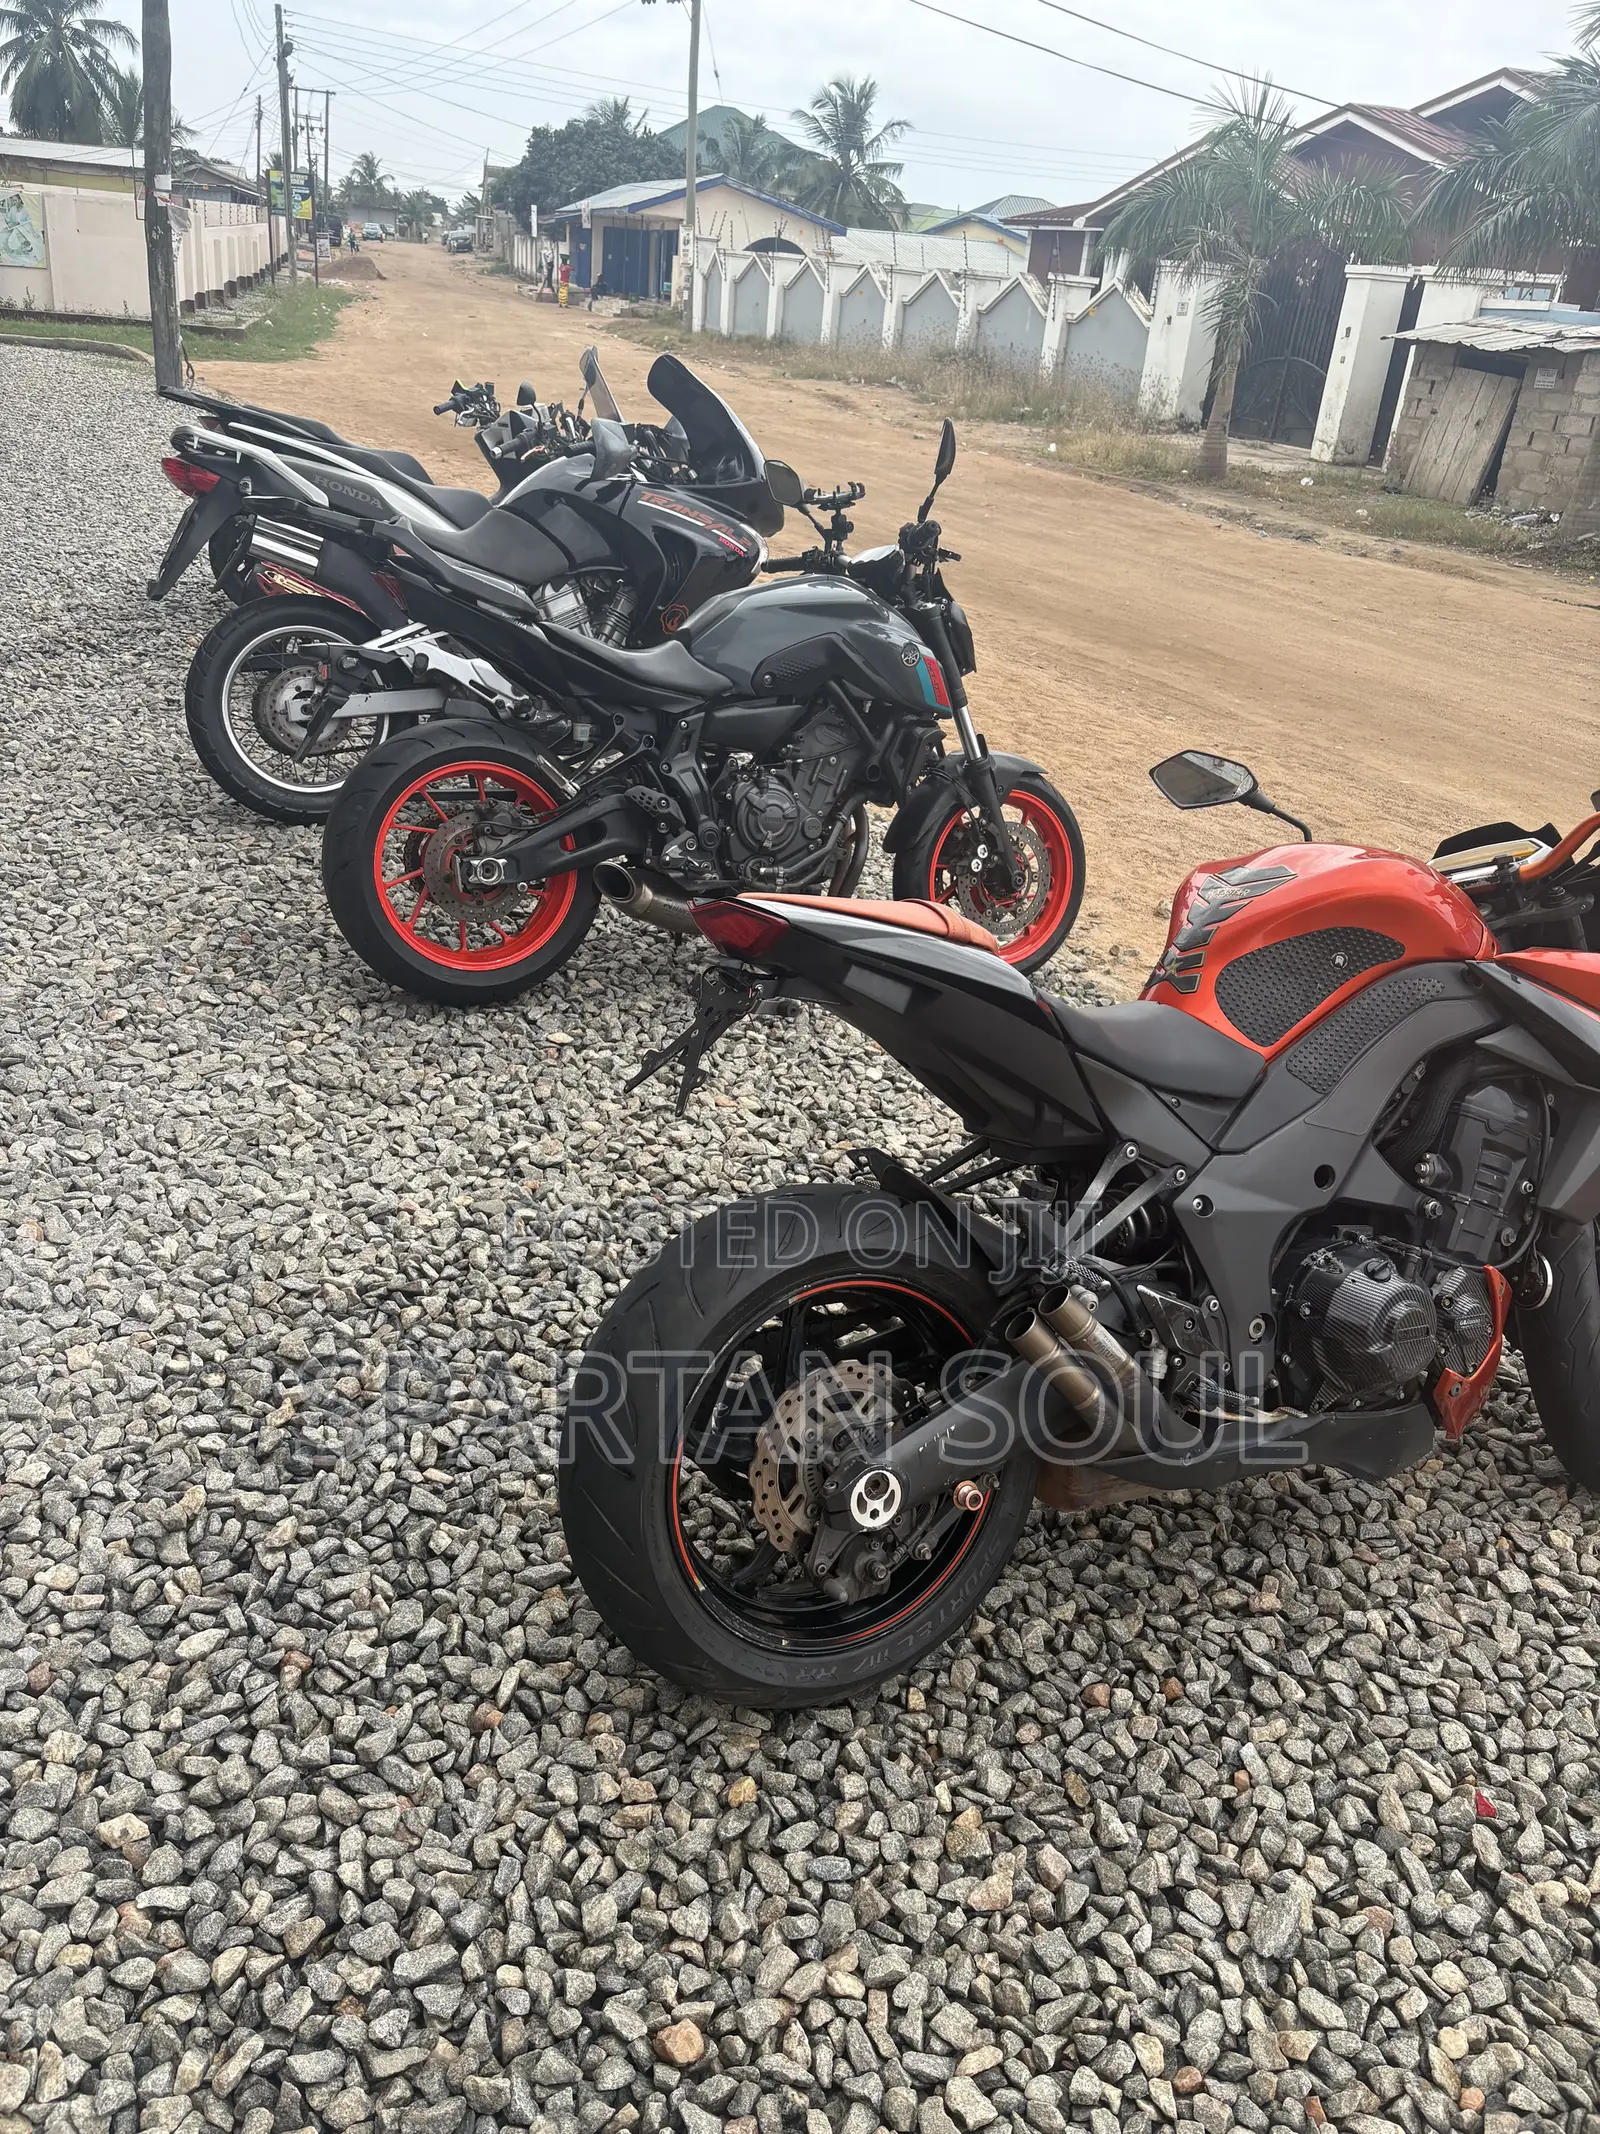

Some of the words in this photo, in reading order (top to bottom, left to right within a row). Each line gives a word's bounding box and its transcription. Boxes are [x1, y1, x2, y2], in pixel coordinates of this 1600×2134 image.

[314, 474, 383, 510] HONDA
[641, 491, 753, 547] TRANSALP
[719, 537, 745, 557] HONDA
